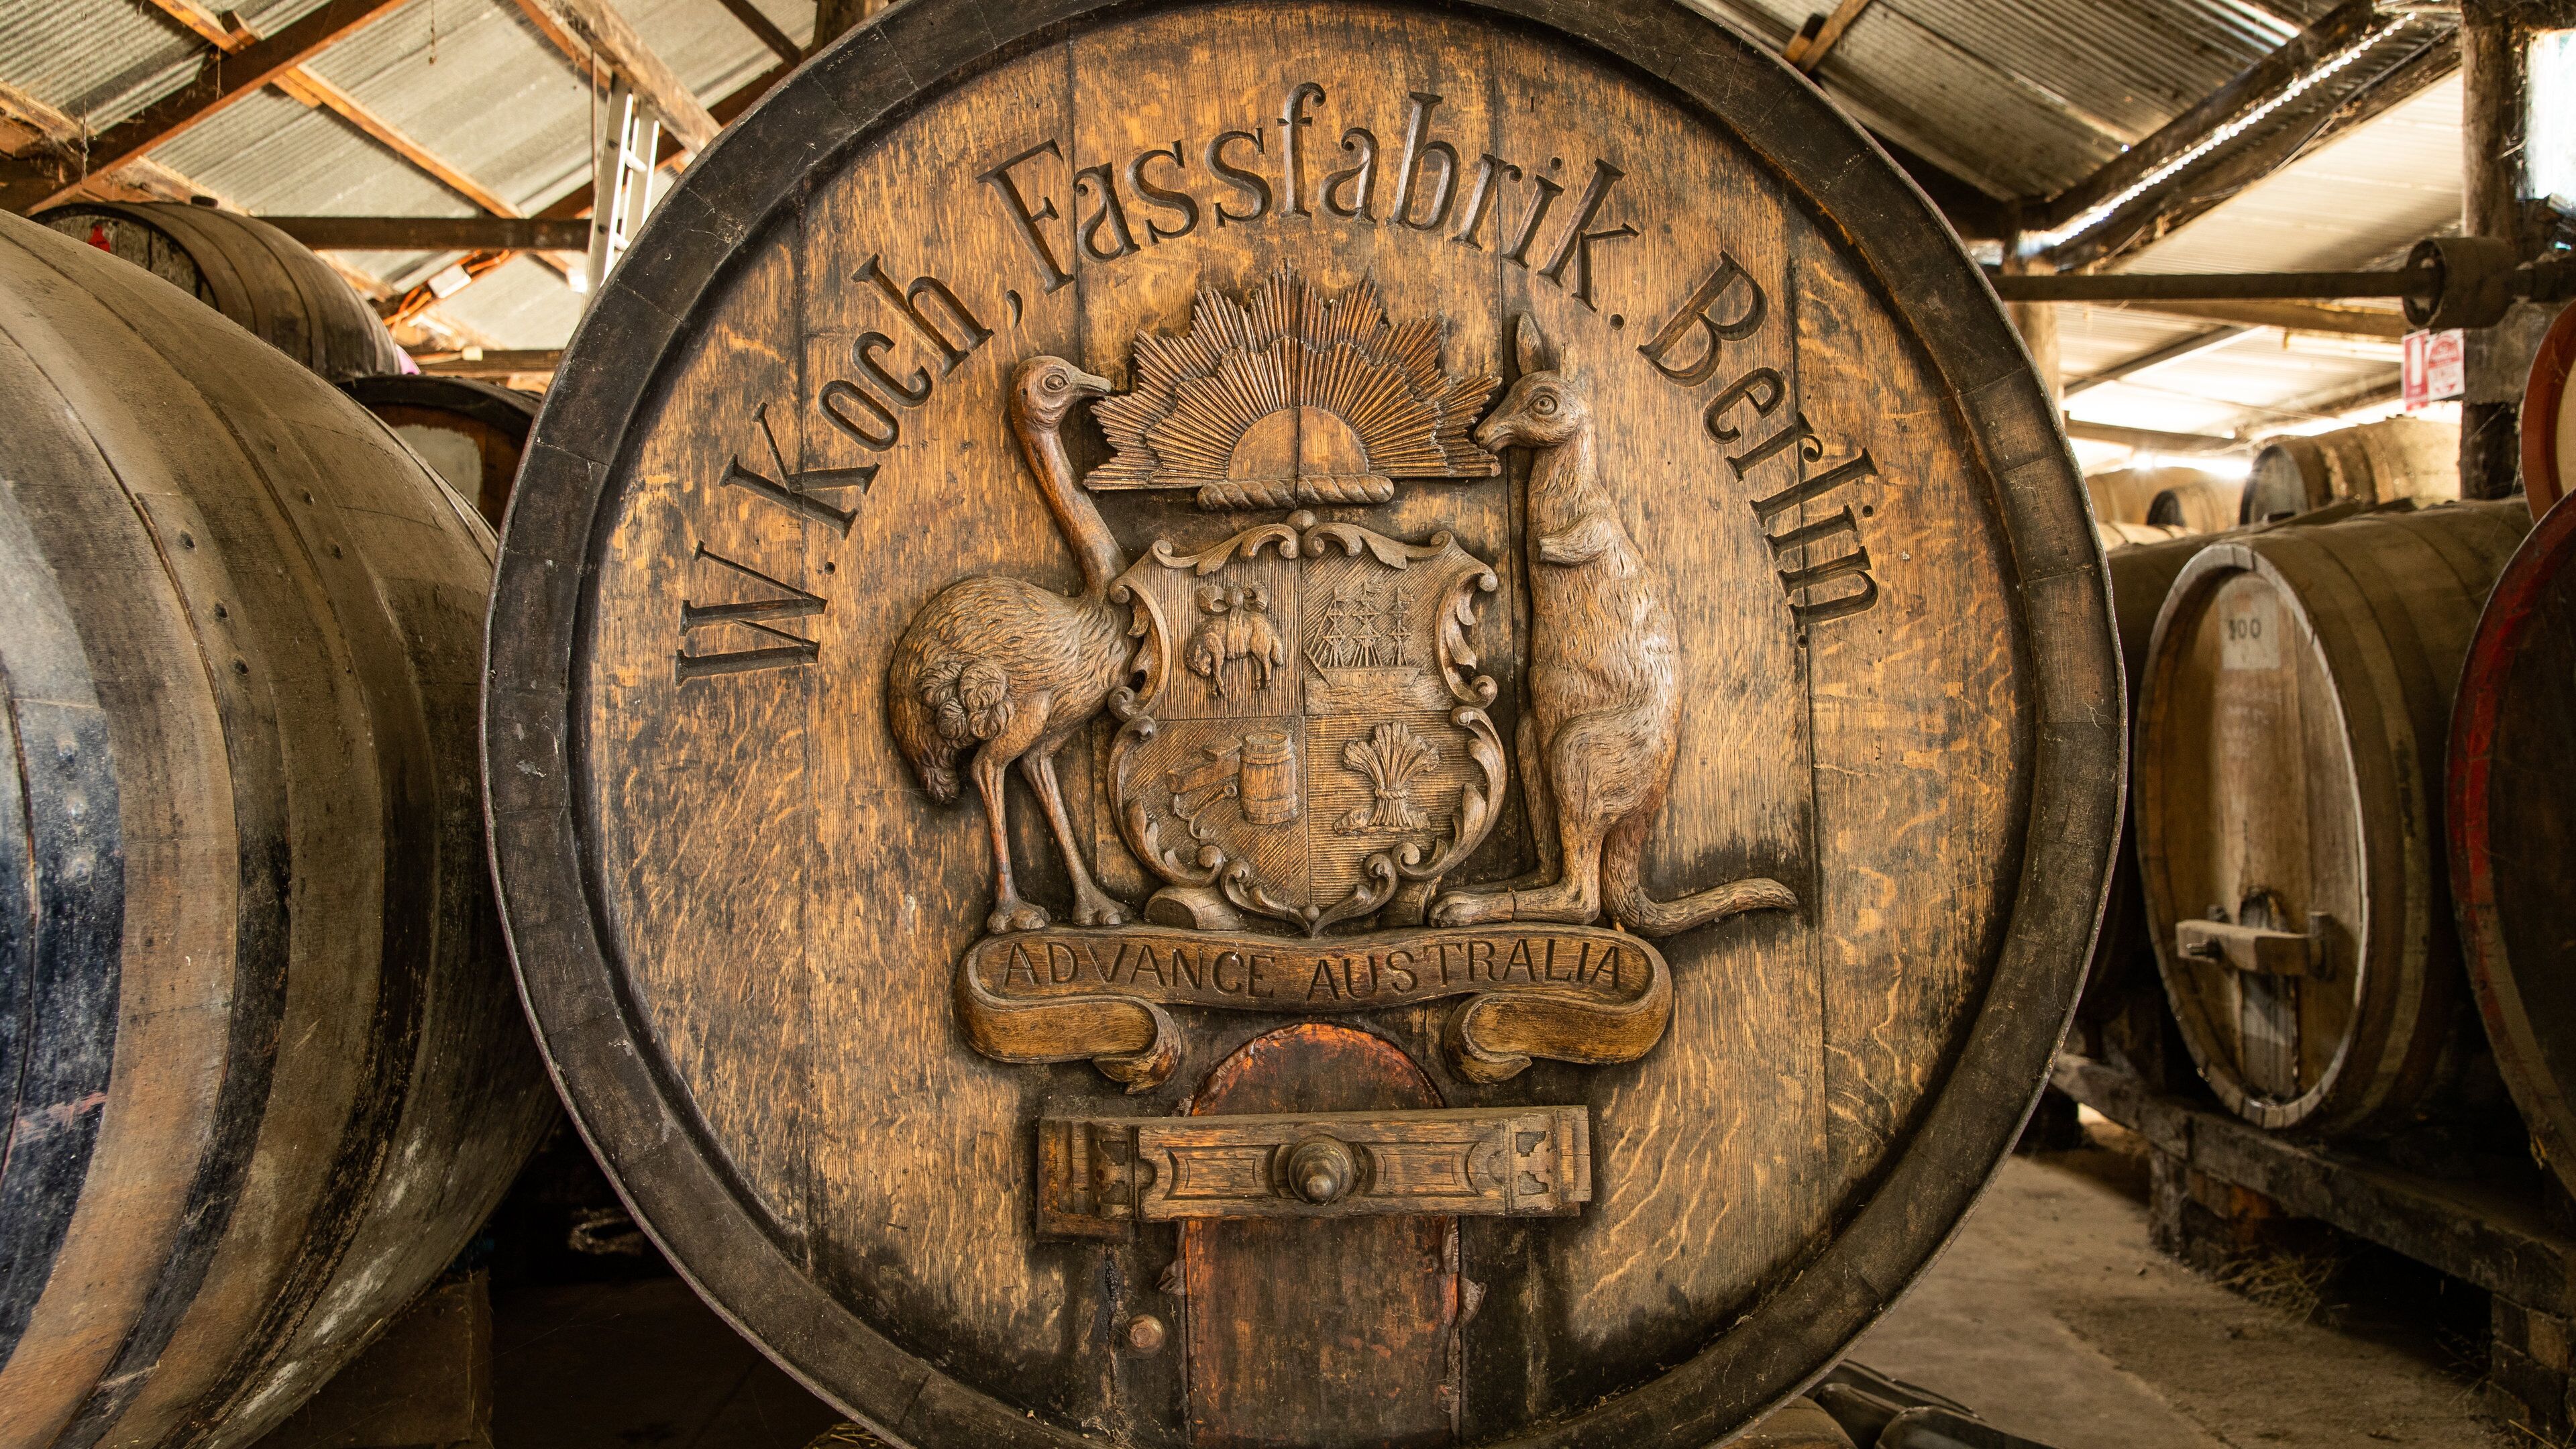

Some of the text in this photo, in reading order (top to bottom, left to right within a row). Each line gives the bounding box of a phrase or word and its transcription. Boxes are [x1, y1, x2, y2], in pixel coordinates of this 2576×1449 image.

[719, 253, 1024, 541] Koch,
[1003, 938, 1621, 1002] ADVANCE AUSTRALIA
